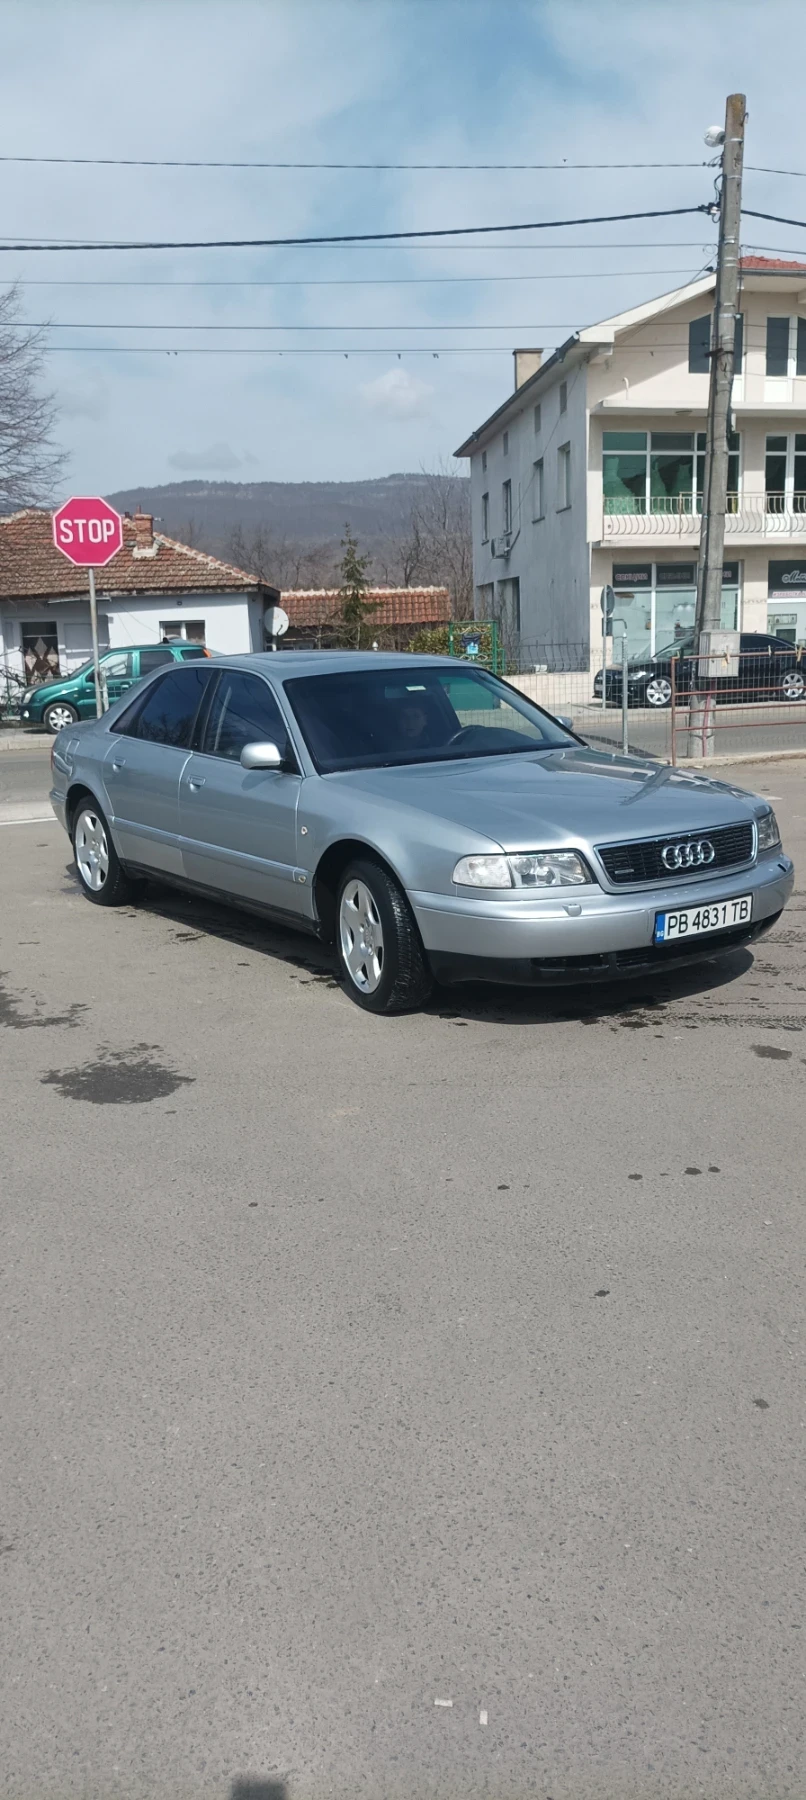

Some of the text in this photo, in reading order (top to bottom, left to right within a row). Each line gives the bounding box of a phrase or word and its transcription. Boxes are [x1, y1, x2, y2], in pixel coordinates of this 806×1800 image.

[60, 519, 115, 543] STOP
[667, 900, 748, 936] PB 4831 TB
[656, 930, 664, 938] BG
